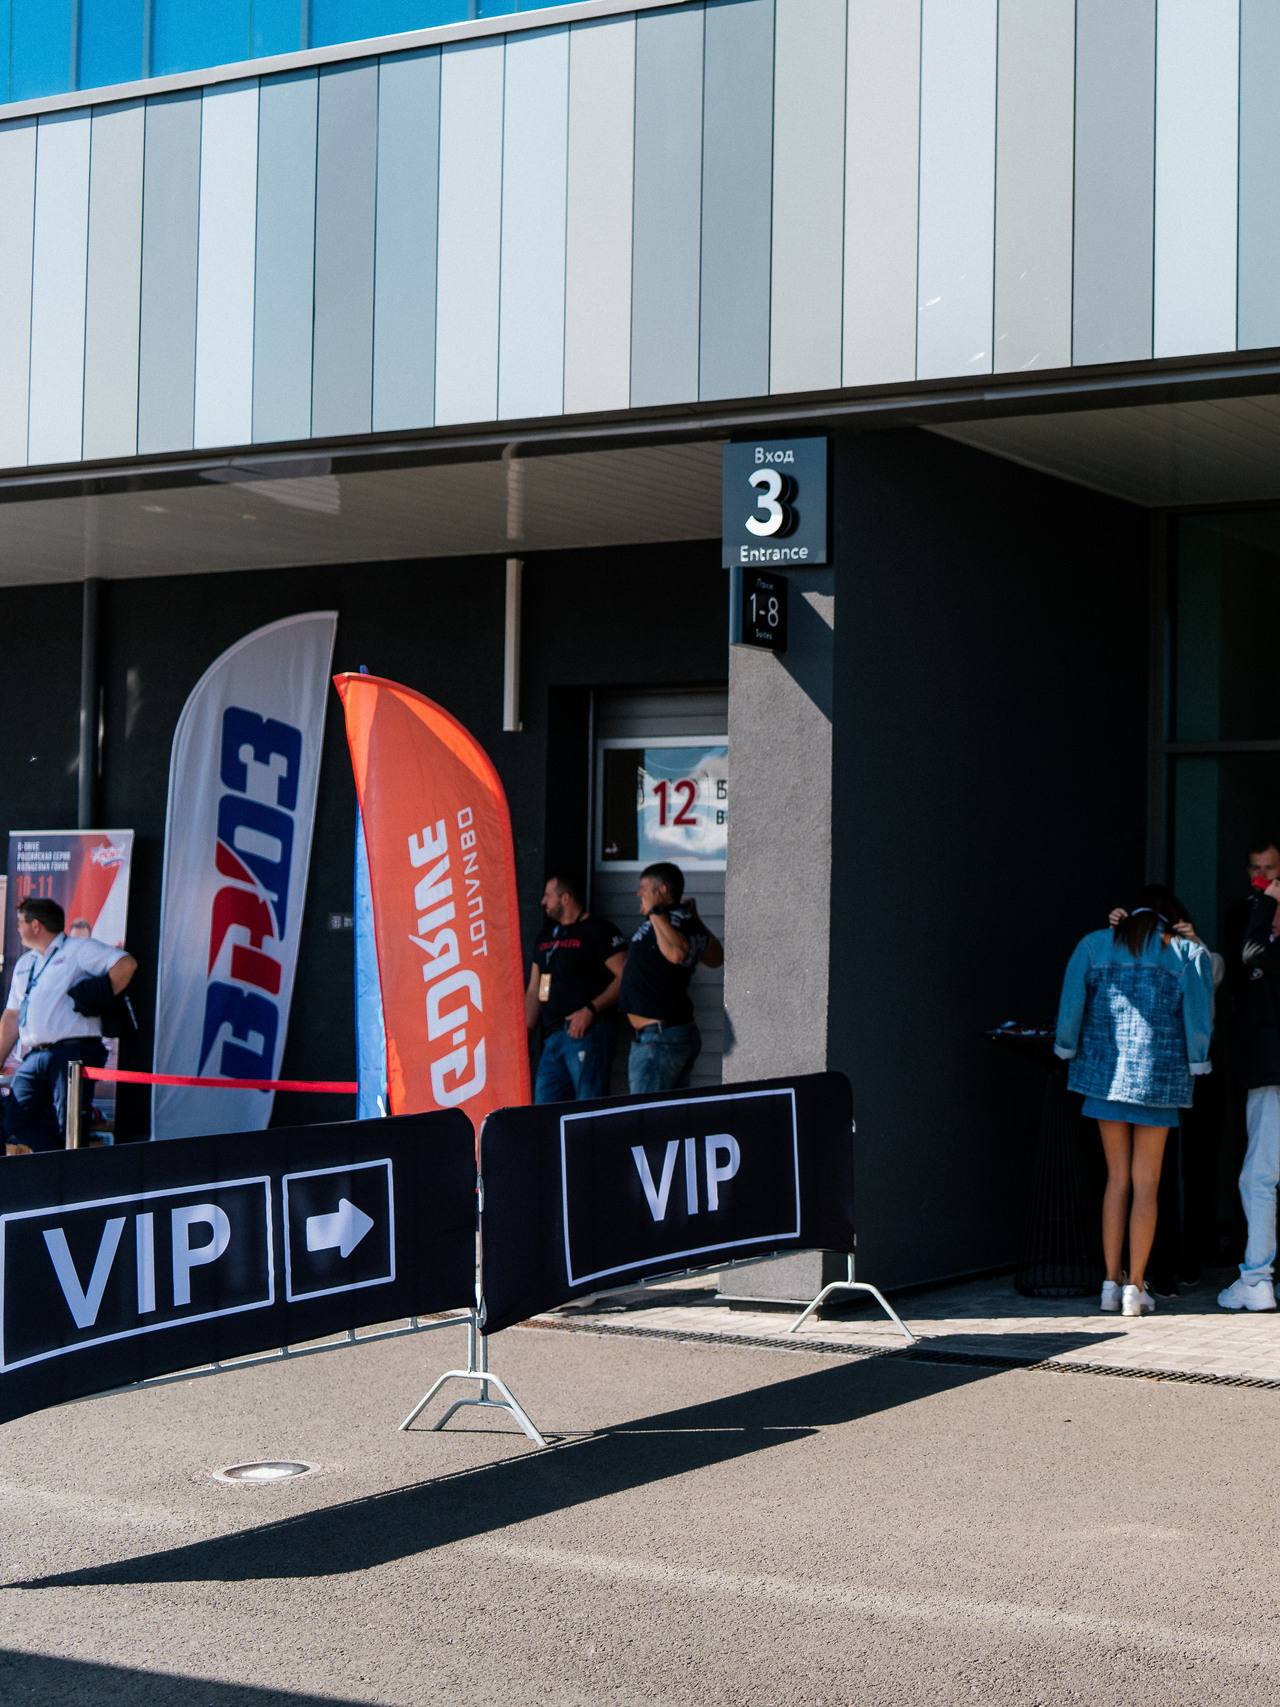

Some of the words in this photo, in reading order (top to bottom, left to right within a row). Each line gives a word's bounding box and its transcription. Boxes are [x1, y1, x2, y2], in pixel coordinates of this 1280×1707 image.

[754, 447, 795, 464] Вход
[745, 468, 784, 537] 3
[740, 545, 809, 562] Entrance
[749, 592, 780, 628] 1-8
[652, 779, 697, 826] 12
[630, 1133, 741, 1222] VIP
[42, 1203, 231, 1329] VIP
